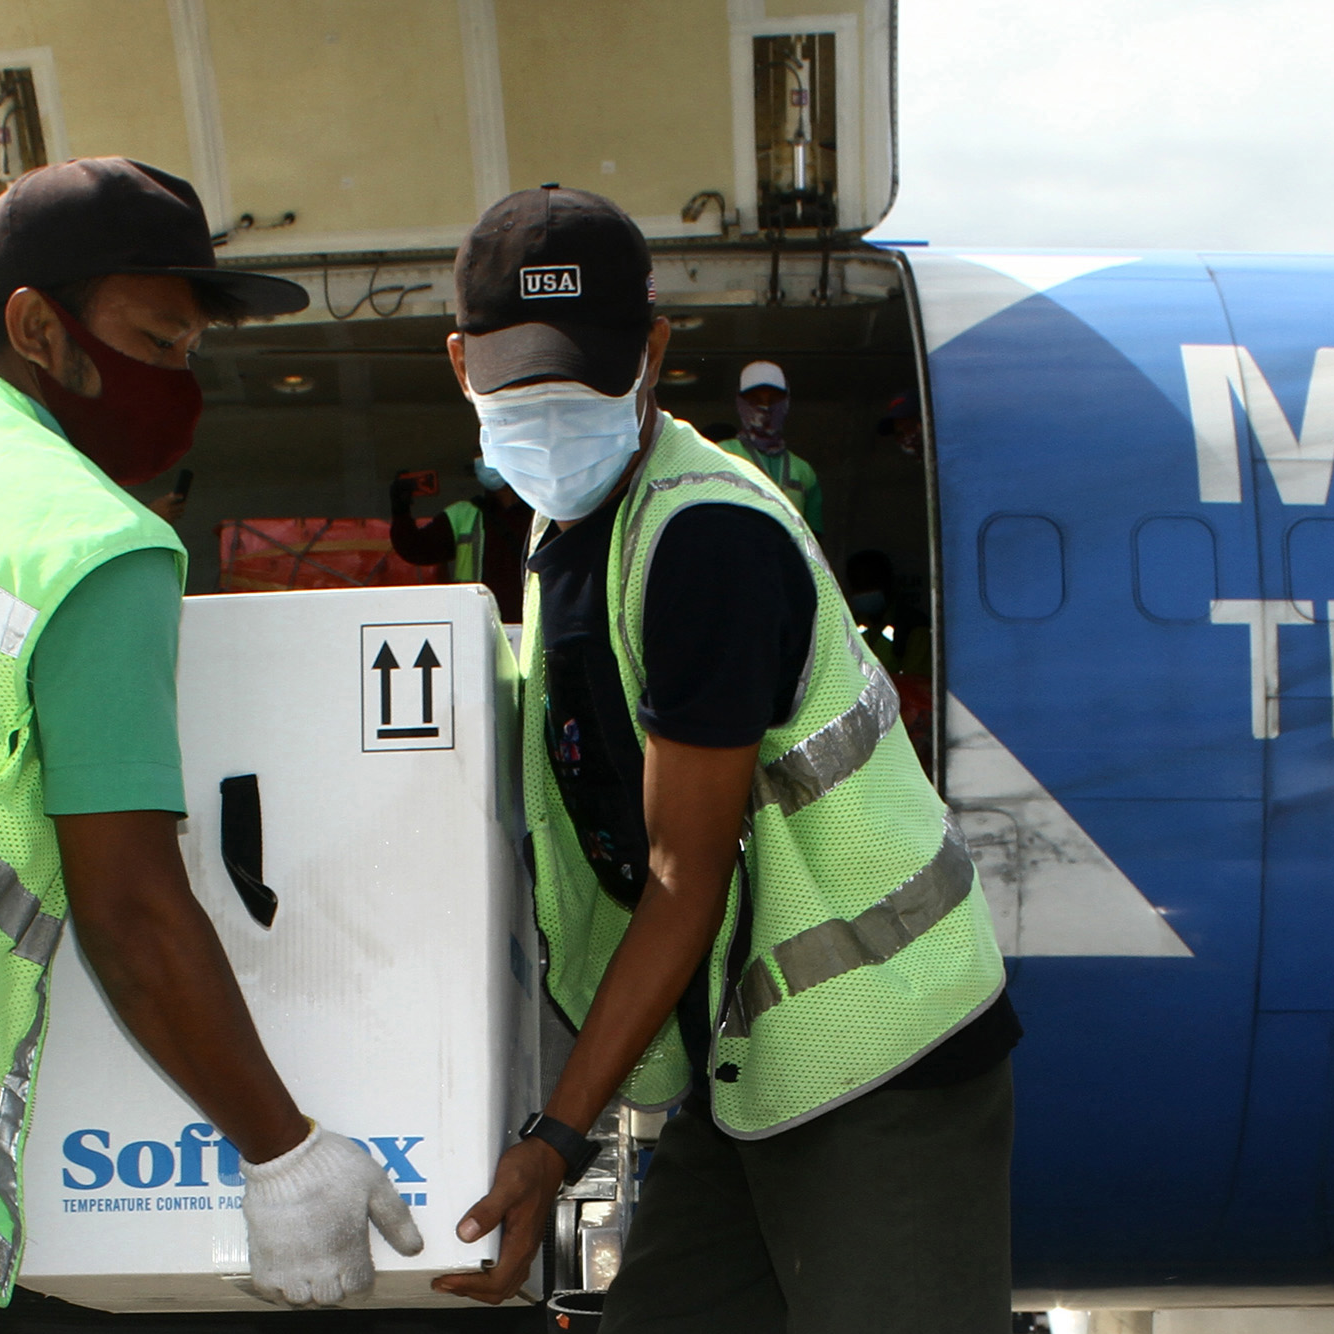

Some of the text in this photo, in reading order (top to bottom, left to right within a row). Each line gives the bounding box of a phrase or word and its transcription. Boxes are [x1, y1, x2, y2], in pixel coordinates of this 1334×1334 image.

[525, 271, 576, 293] USA
[62, 1122, 427, 1191] Softx
[63, 1197, 153, 1213] TEMPERATURE
[156, 1196, 214, 1211] CONTROL
